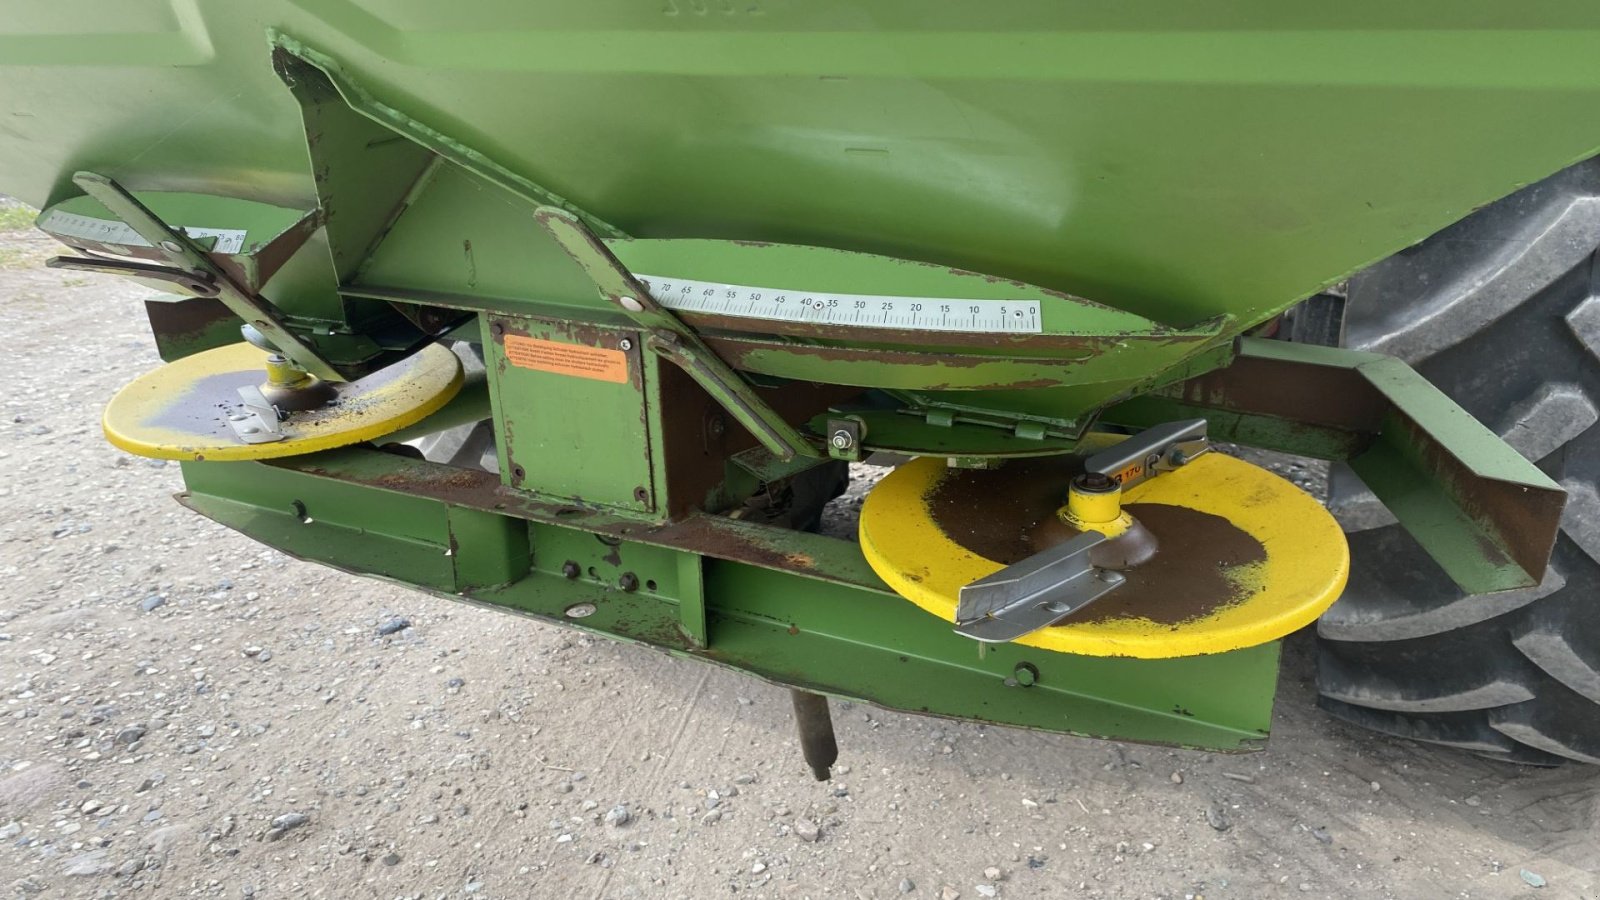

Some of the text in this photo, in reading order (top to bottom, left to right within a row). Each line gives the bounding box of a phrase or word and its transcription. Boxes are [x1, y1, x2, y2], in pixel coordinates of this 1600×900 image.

[661, 283, 1036, 315] 70 65 60 55 50 45 40 35 30 25 20 15 10 5 0
